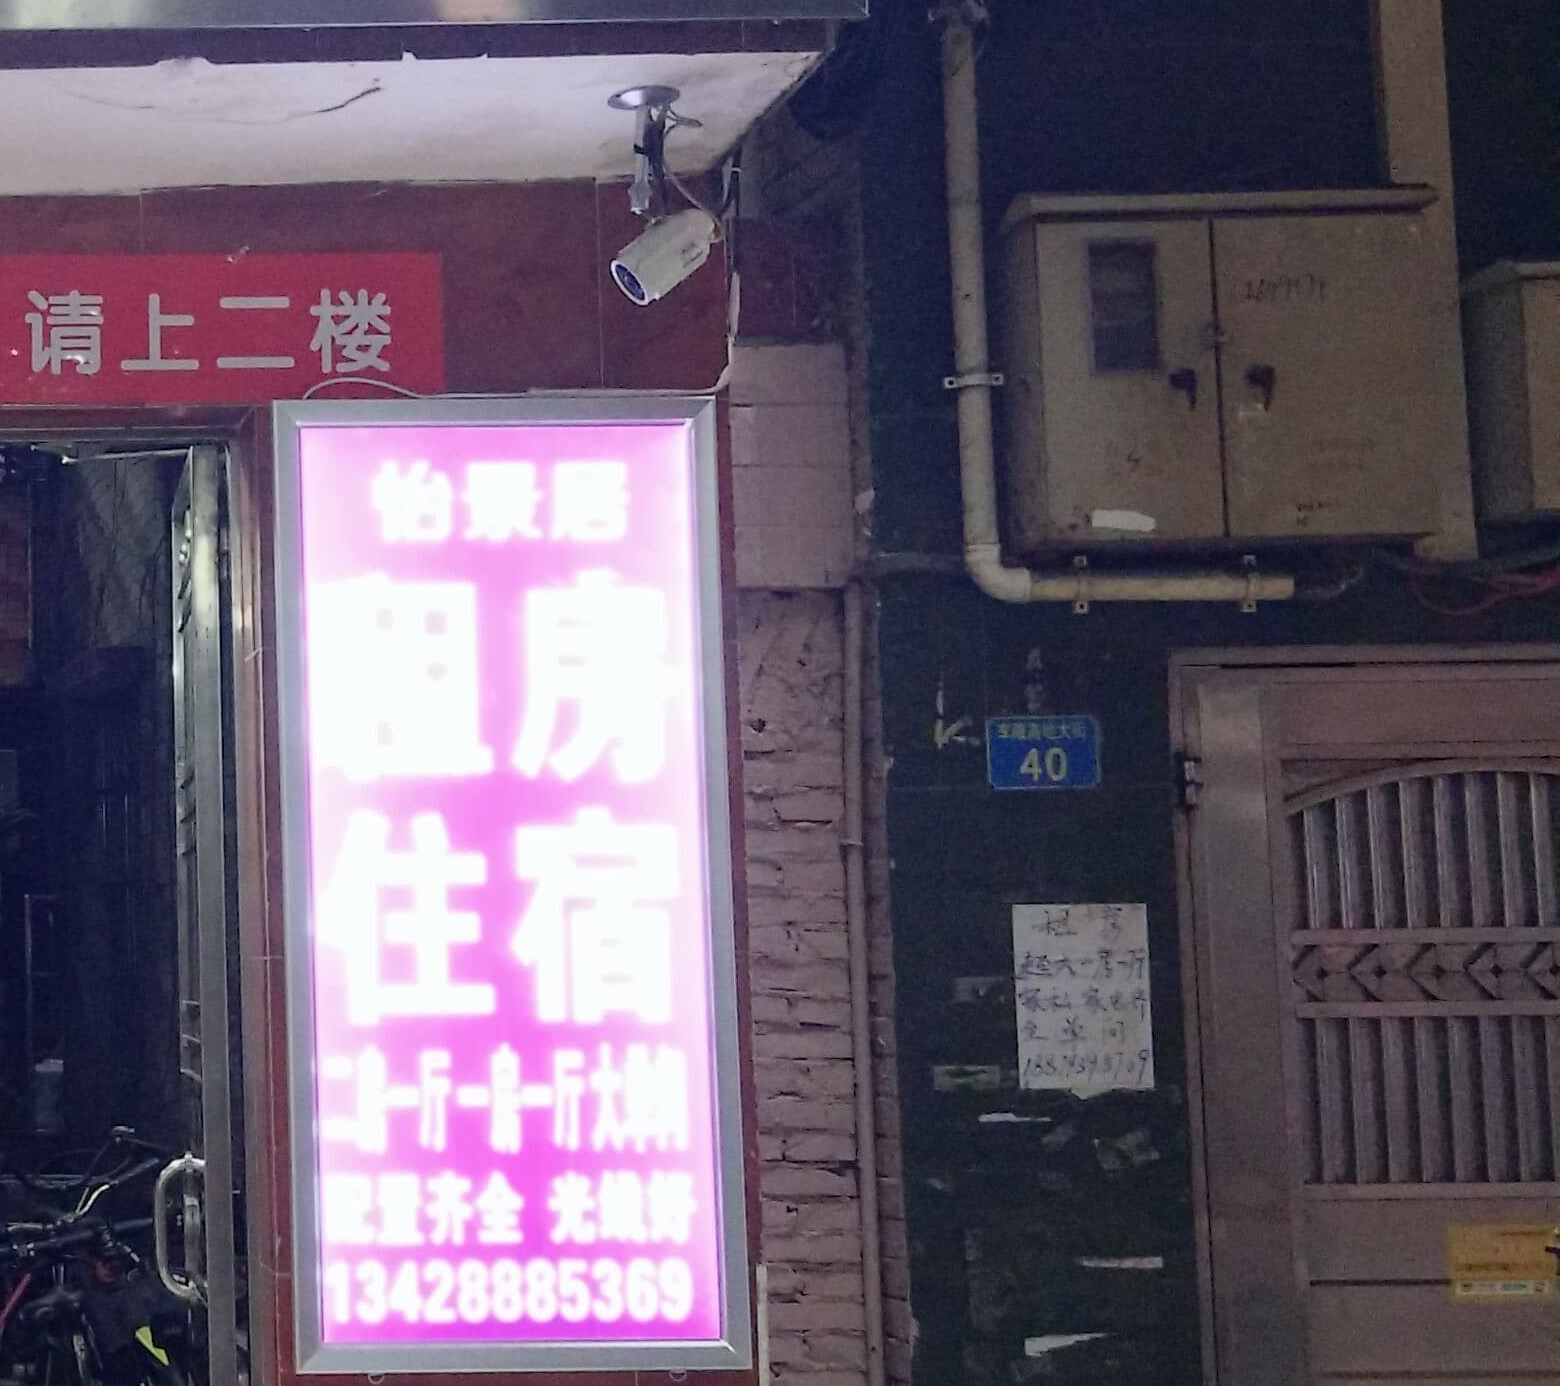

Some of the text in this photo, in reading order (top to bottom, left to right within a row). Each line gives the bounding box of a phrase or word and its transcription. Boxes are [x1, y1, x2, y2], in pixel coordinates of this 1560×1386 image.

[27, 289, 393, 376] 请上二楼
[371, 461, 630, 542] 怡景居
[310, 568, 678, 785] 租房
[1020, 747, 1067, 781] 40
[315, 806, 682, 1026] 住宿
[326, 1256, 695, 1325] 13428885369
